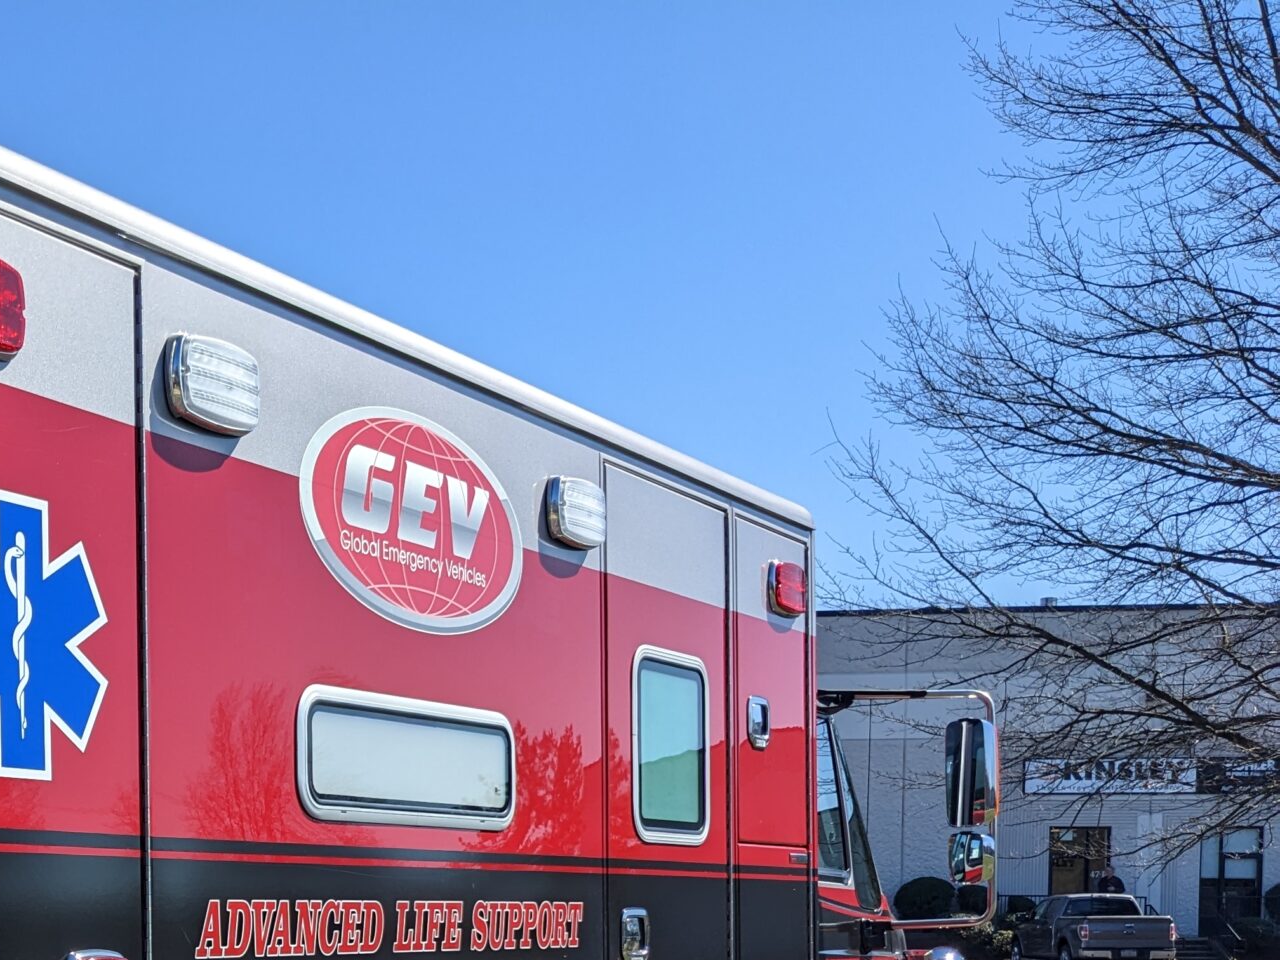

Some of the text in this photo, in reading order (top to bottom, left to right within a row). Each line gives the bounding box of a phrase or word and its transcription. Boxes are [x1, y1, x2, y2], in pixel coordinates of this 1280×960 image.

[341, 444, 490, 560] GEV
[340, 529, 486, 587] Global Emergency Vehicles
[195, 899, 583, 959] ADVANCED LIFE SUPPORT
